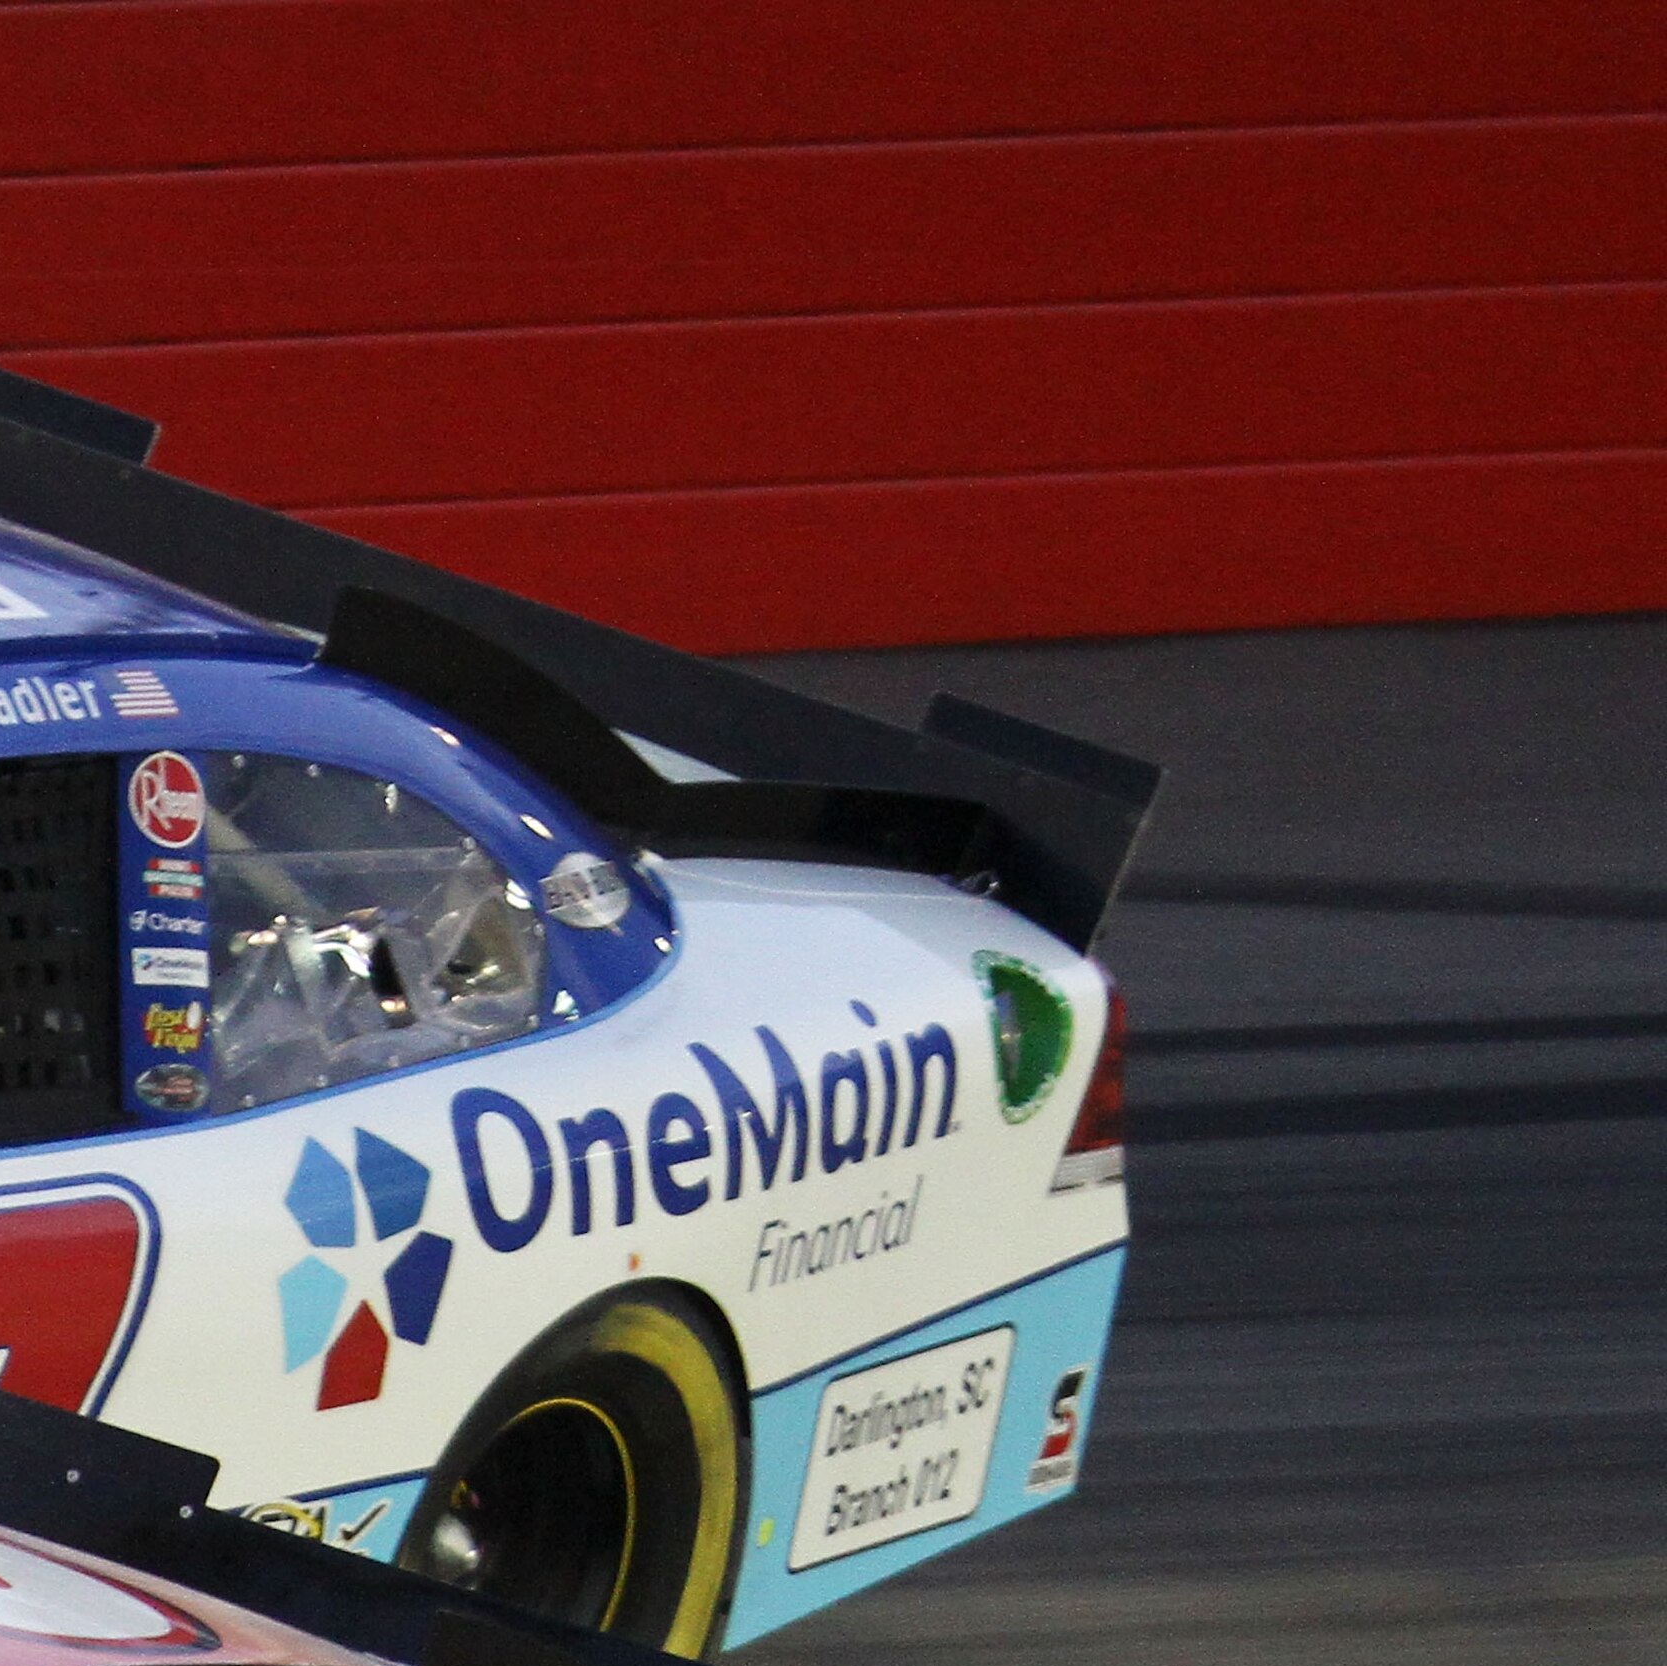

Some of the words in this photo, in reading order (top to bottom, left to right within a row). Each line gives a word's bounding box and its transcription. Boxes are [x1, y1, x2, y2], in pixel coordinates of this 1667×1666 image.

[449, 1001, 959, 1254] OneMain
[749, 1175, 924, 1294] Financial
[957, 1356, 995, 1414] SC
[825, 1464, 910, 1536] Branch
